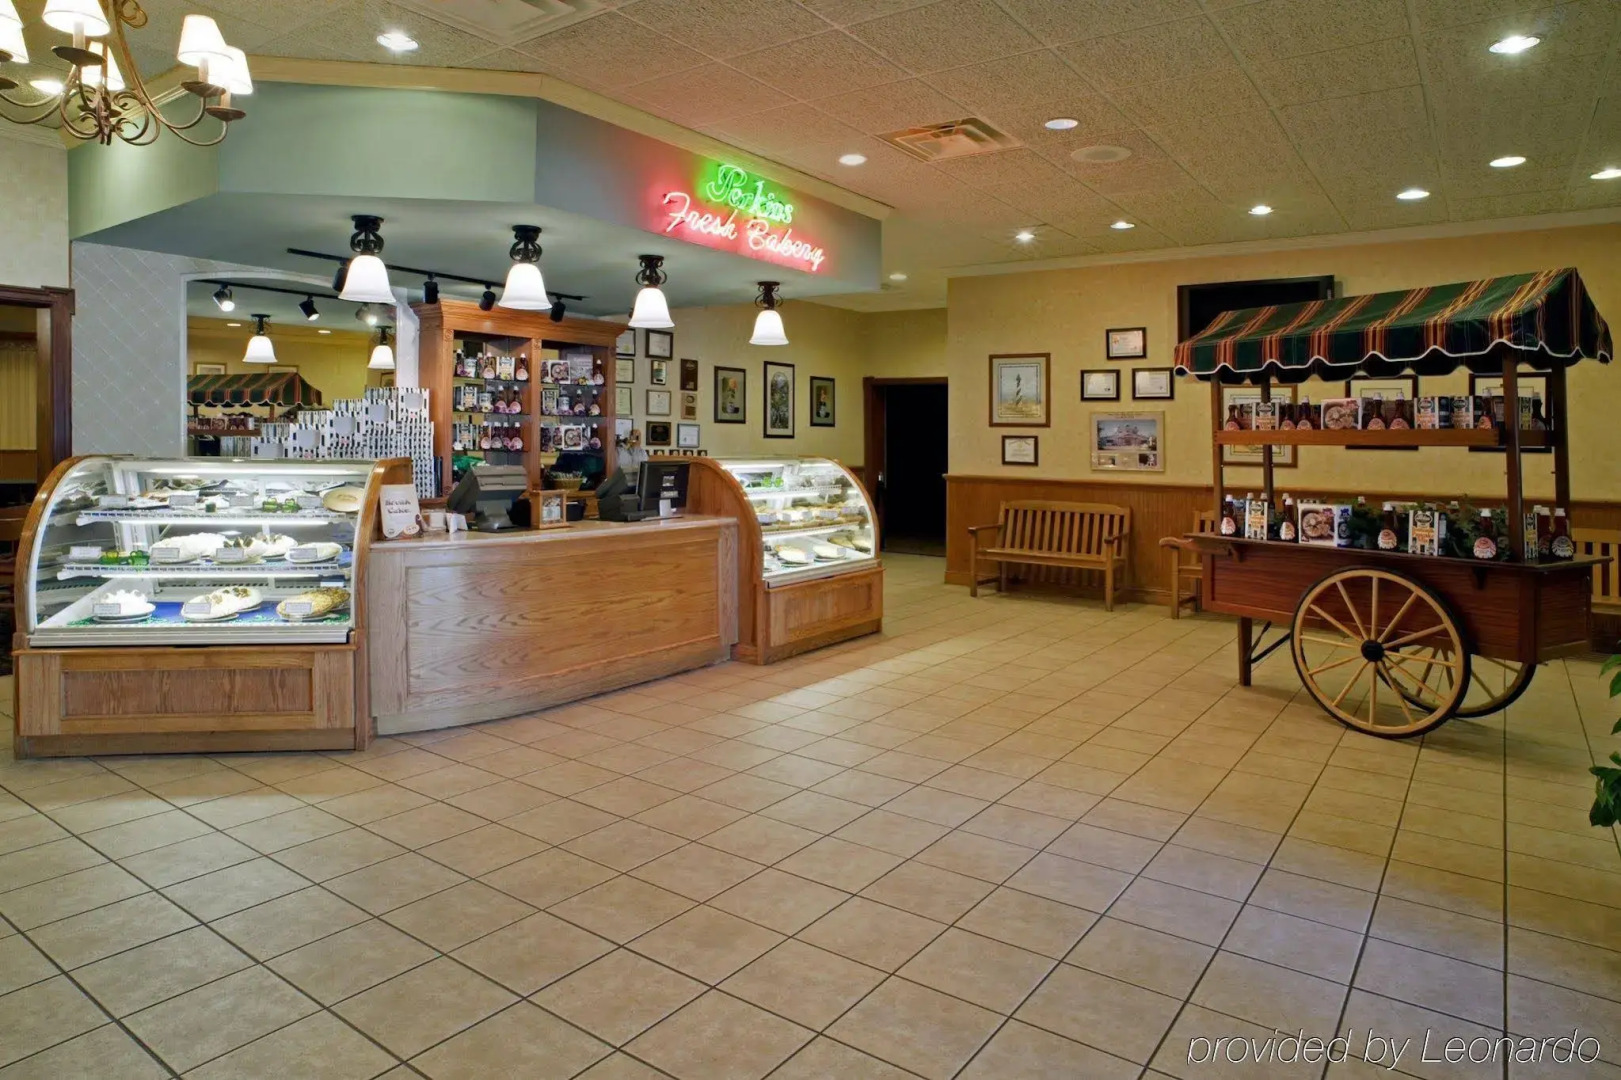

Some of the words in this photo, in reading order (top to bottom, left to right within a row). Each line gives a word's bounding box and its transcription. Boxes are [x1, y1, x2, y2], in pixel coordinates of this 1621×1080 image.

[706, 164, 793, 224] Perkins
[663, 192, 738, 240] Fresh
[746, 219, 826, 271] Bakery
